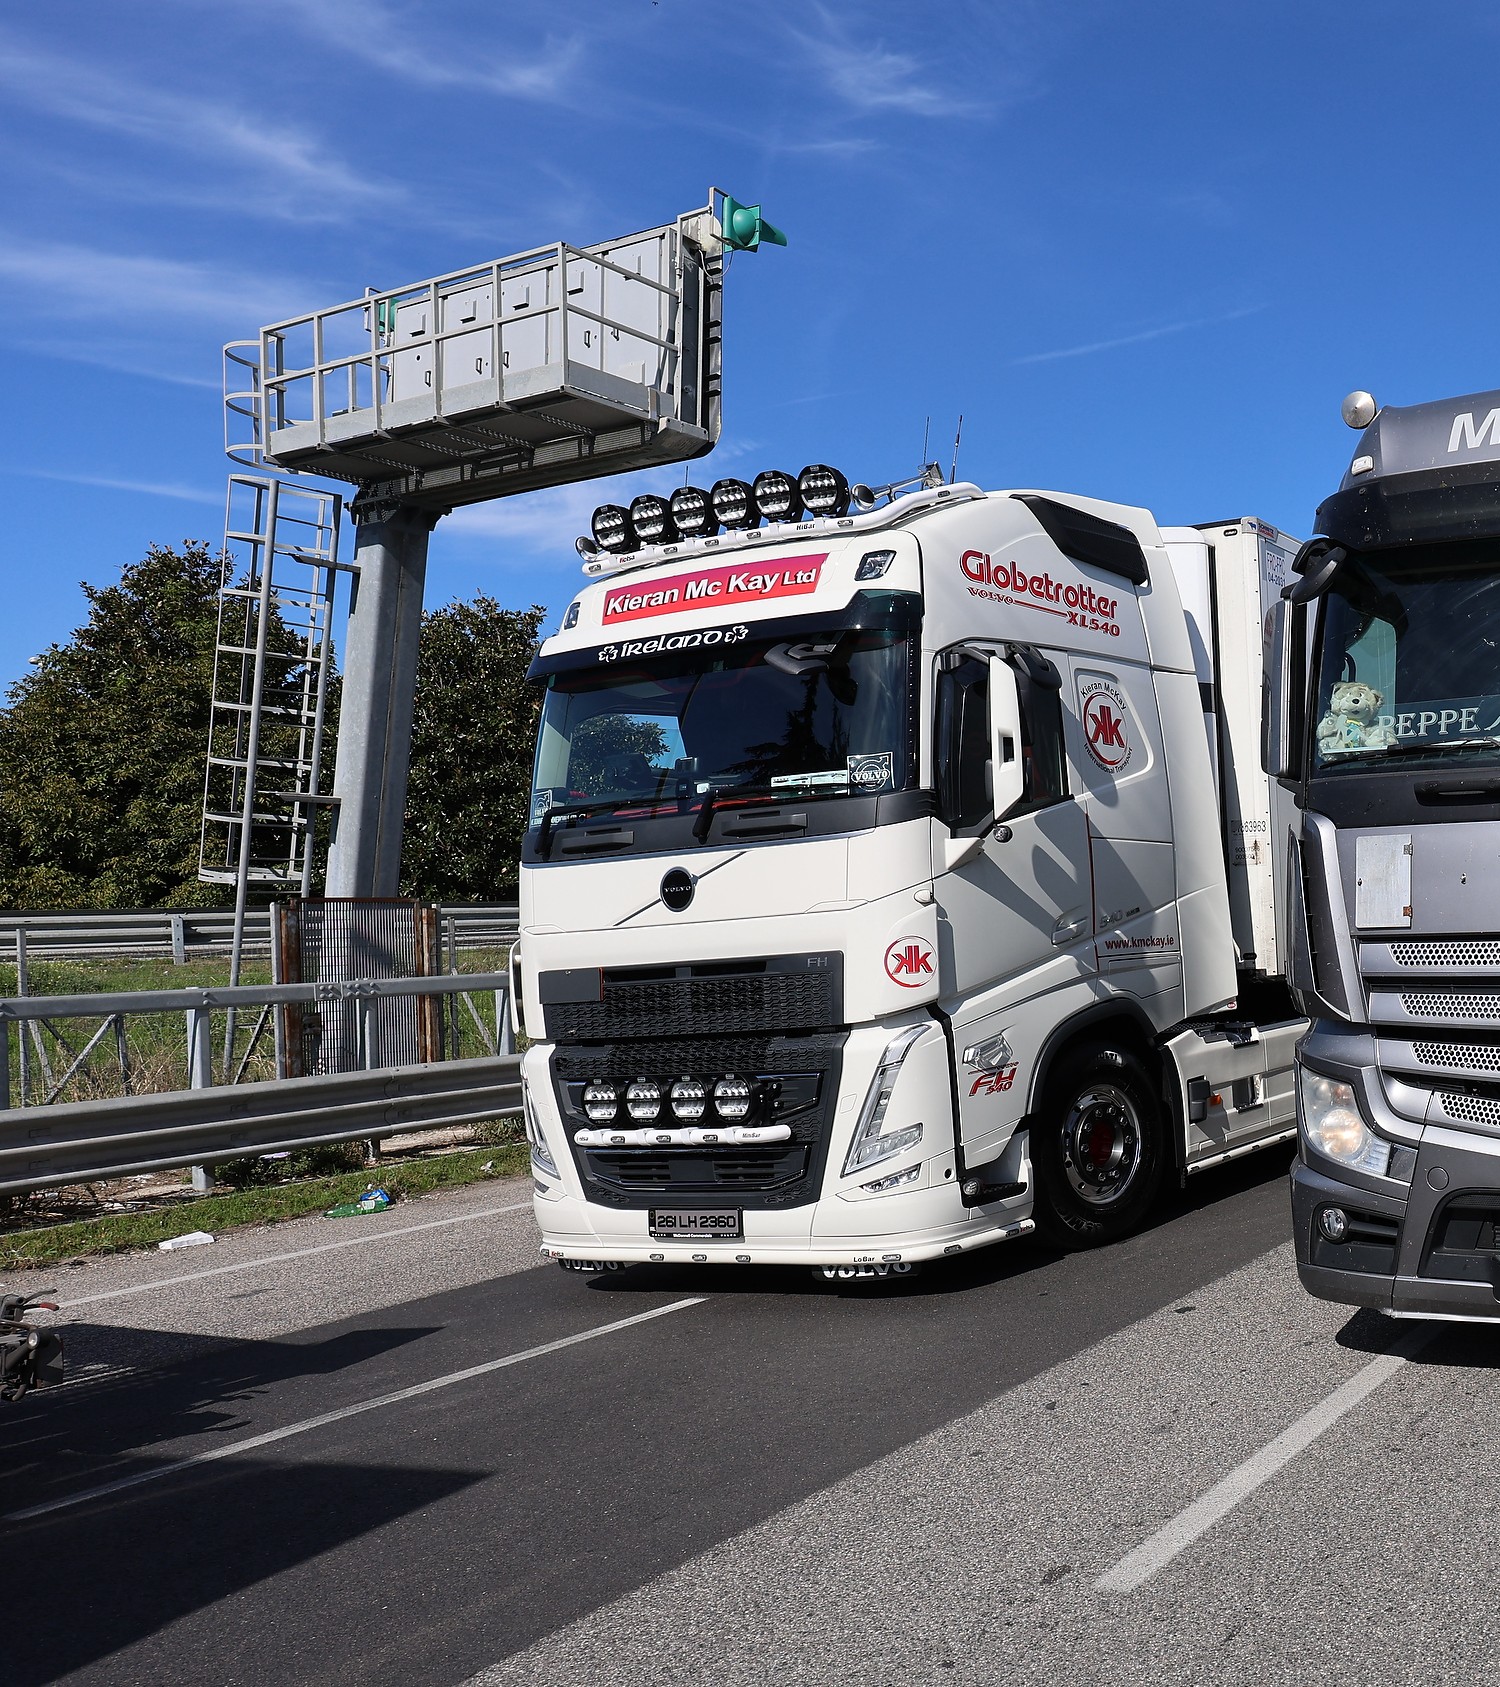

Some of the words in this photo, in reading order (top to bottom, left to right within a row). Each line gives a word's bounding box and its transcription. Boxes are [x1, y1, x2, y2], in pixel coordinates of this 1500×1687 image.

[960, 550, 1118, 619] Globetrotter
[605, 588, 679, 617] Kieran
[683, 580, 721, 600] Mc
[726, 571, 780, 594] Kay
[783, 569, 817, 585] Ltd
[967, 587, 1014, 604] VOLVO
[1080, 682, 1103, 699] Kieran
[1104, 682, 1127, 710] McKay
[1378, 707, 1481, 739] PEPPE
[854, 770, 889, 781] VOLVO
[664, 885, 692, 893] VOLVO
[1105, 935, 1175, 949] www.kmckay.ie
[807, 957, 828, 968] FH
[969, 1068, 1017, 1097] FH
[657, 1215, 676, 1228] 261
[679, 1215, 697, 1228] LH
[700, 1215, 736, 1228] 2360
[821, 1262, 912, 1278] VOLVO
